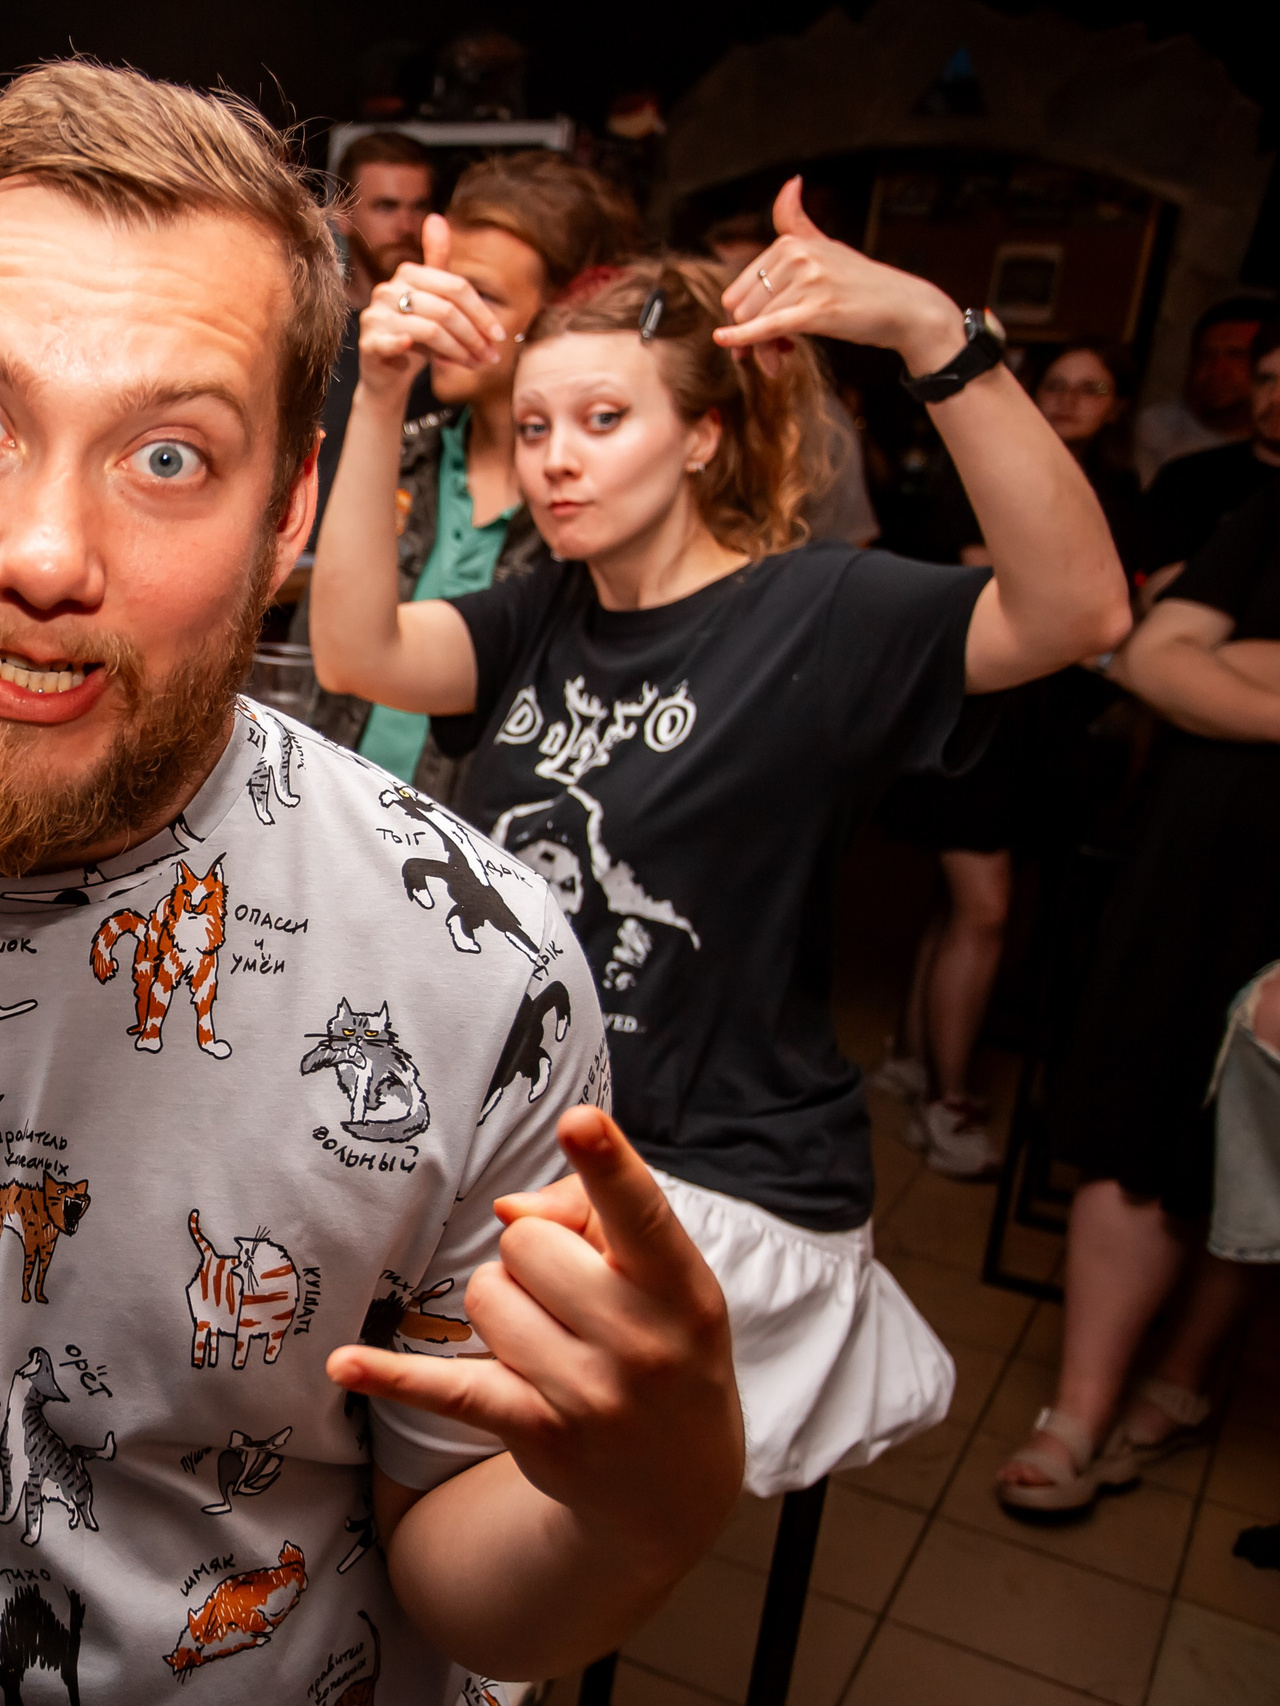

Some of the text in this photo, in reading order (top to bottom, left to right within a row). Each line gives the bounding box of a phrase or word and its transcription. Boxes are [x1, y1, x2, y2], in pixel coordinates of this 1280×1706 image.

[293, 1266, 322, 1336] КУШАТЬ
[379, 1269, 417, 1296] ТИХ
[180, 1553, 236, 1598] ШМЯК
